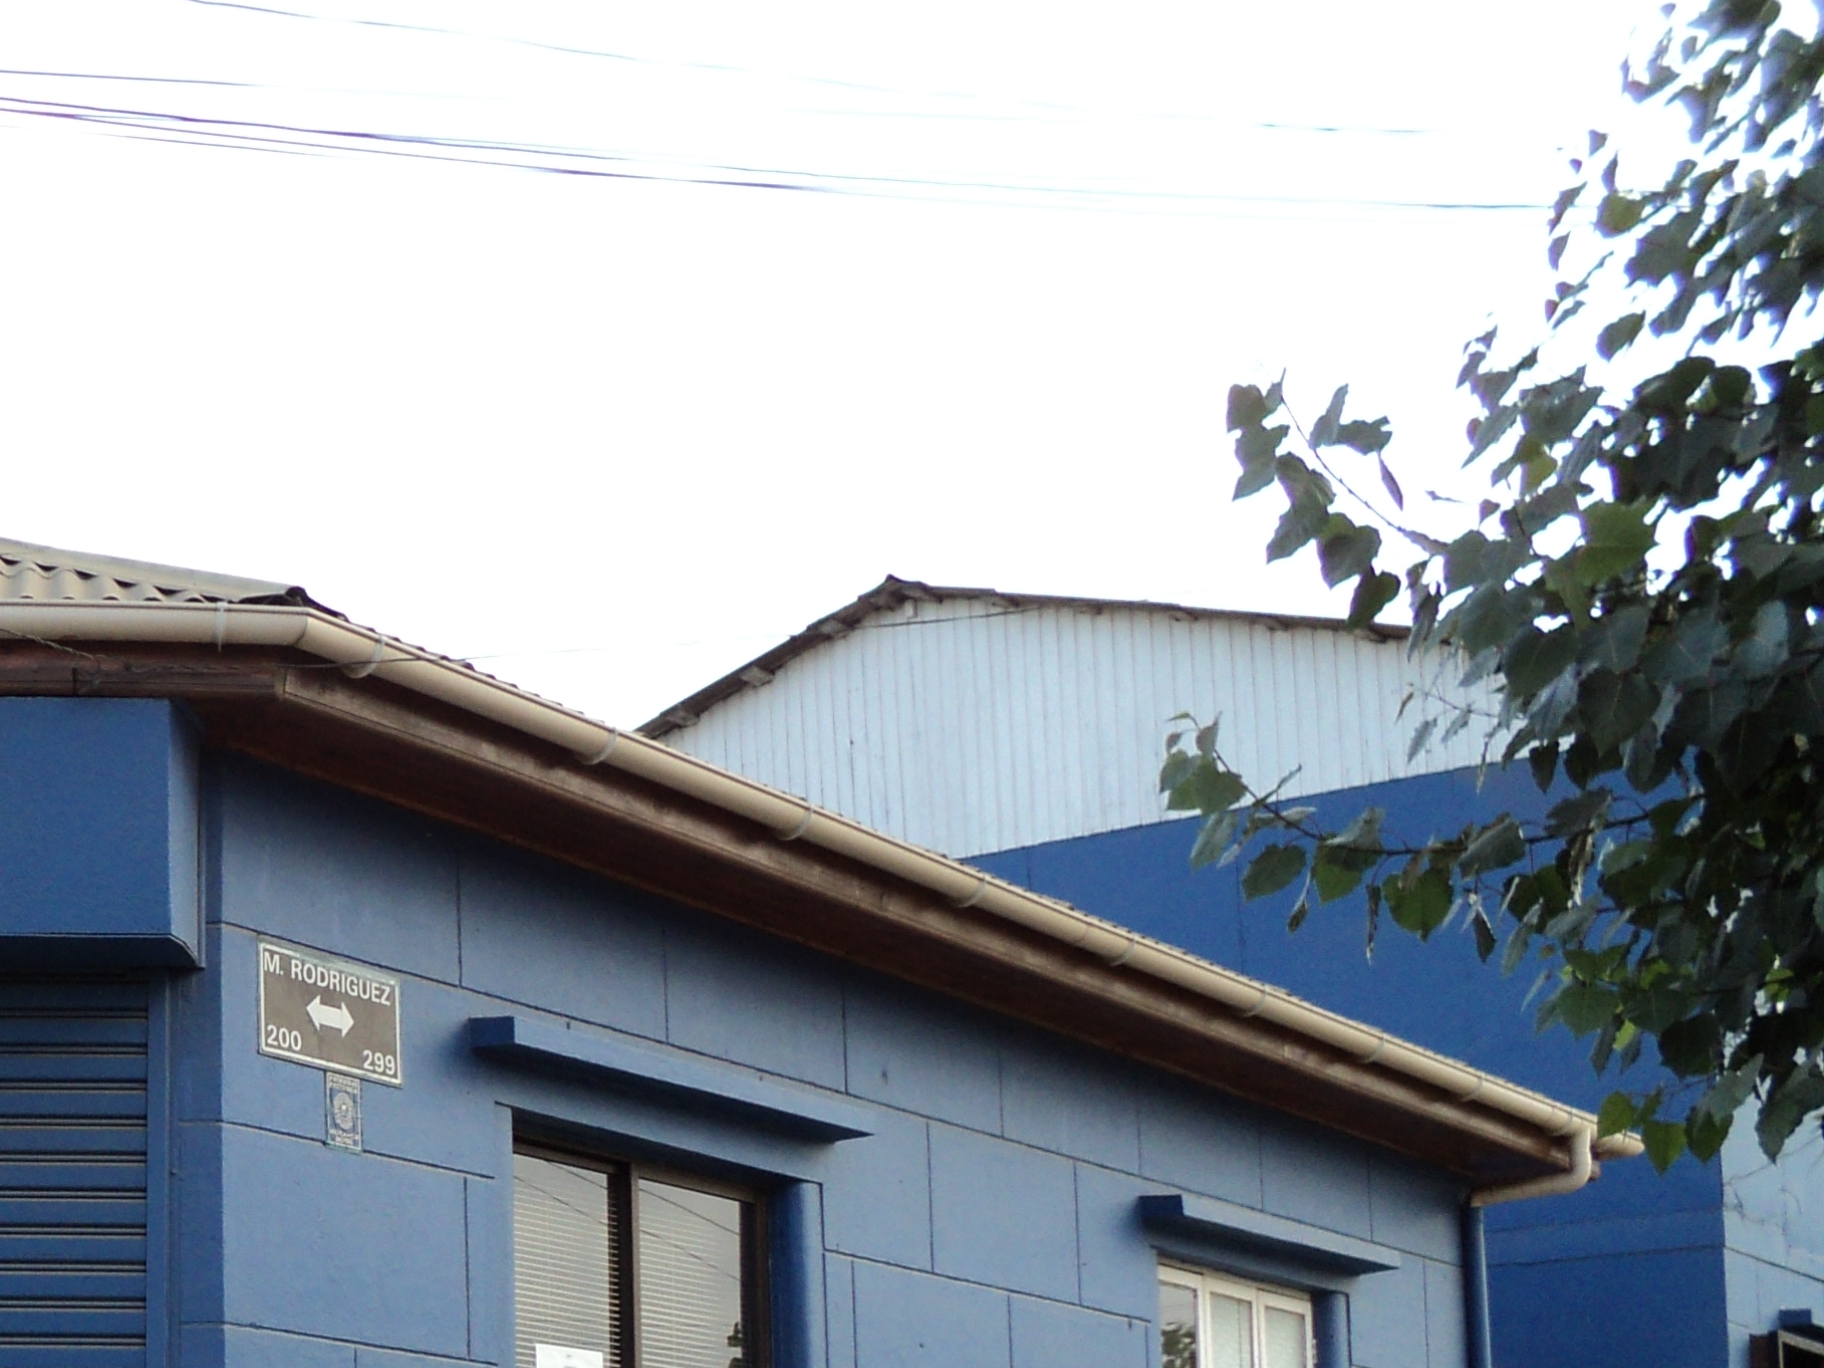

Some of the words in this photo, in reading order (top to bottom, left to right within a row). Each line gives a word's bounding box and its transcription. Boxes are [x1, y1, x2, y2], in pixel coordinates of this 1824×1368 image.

[263, 951, 284, 976] M.
[290, 959, 392, 1006] RODRIGUEZ
[266, 1024, 302, 1051] 200
[362, 1049, 396, 1076] 299
